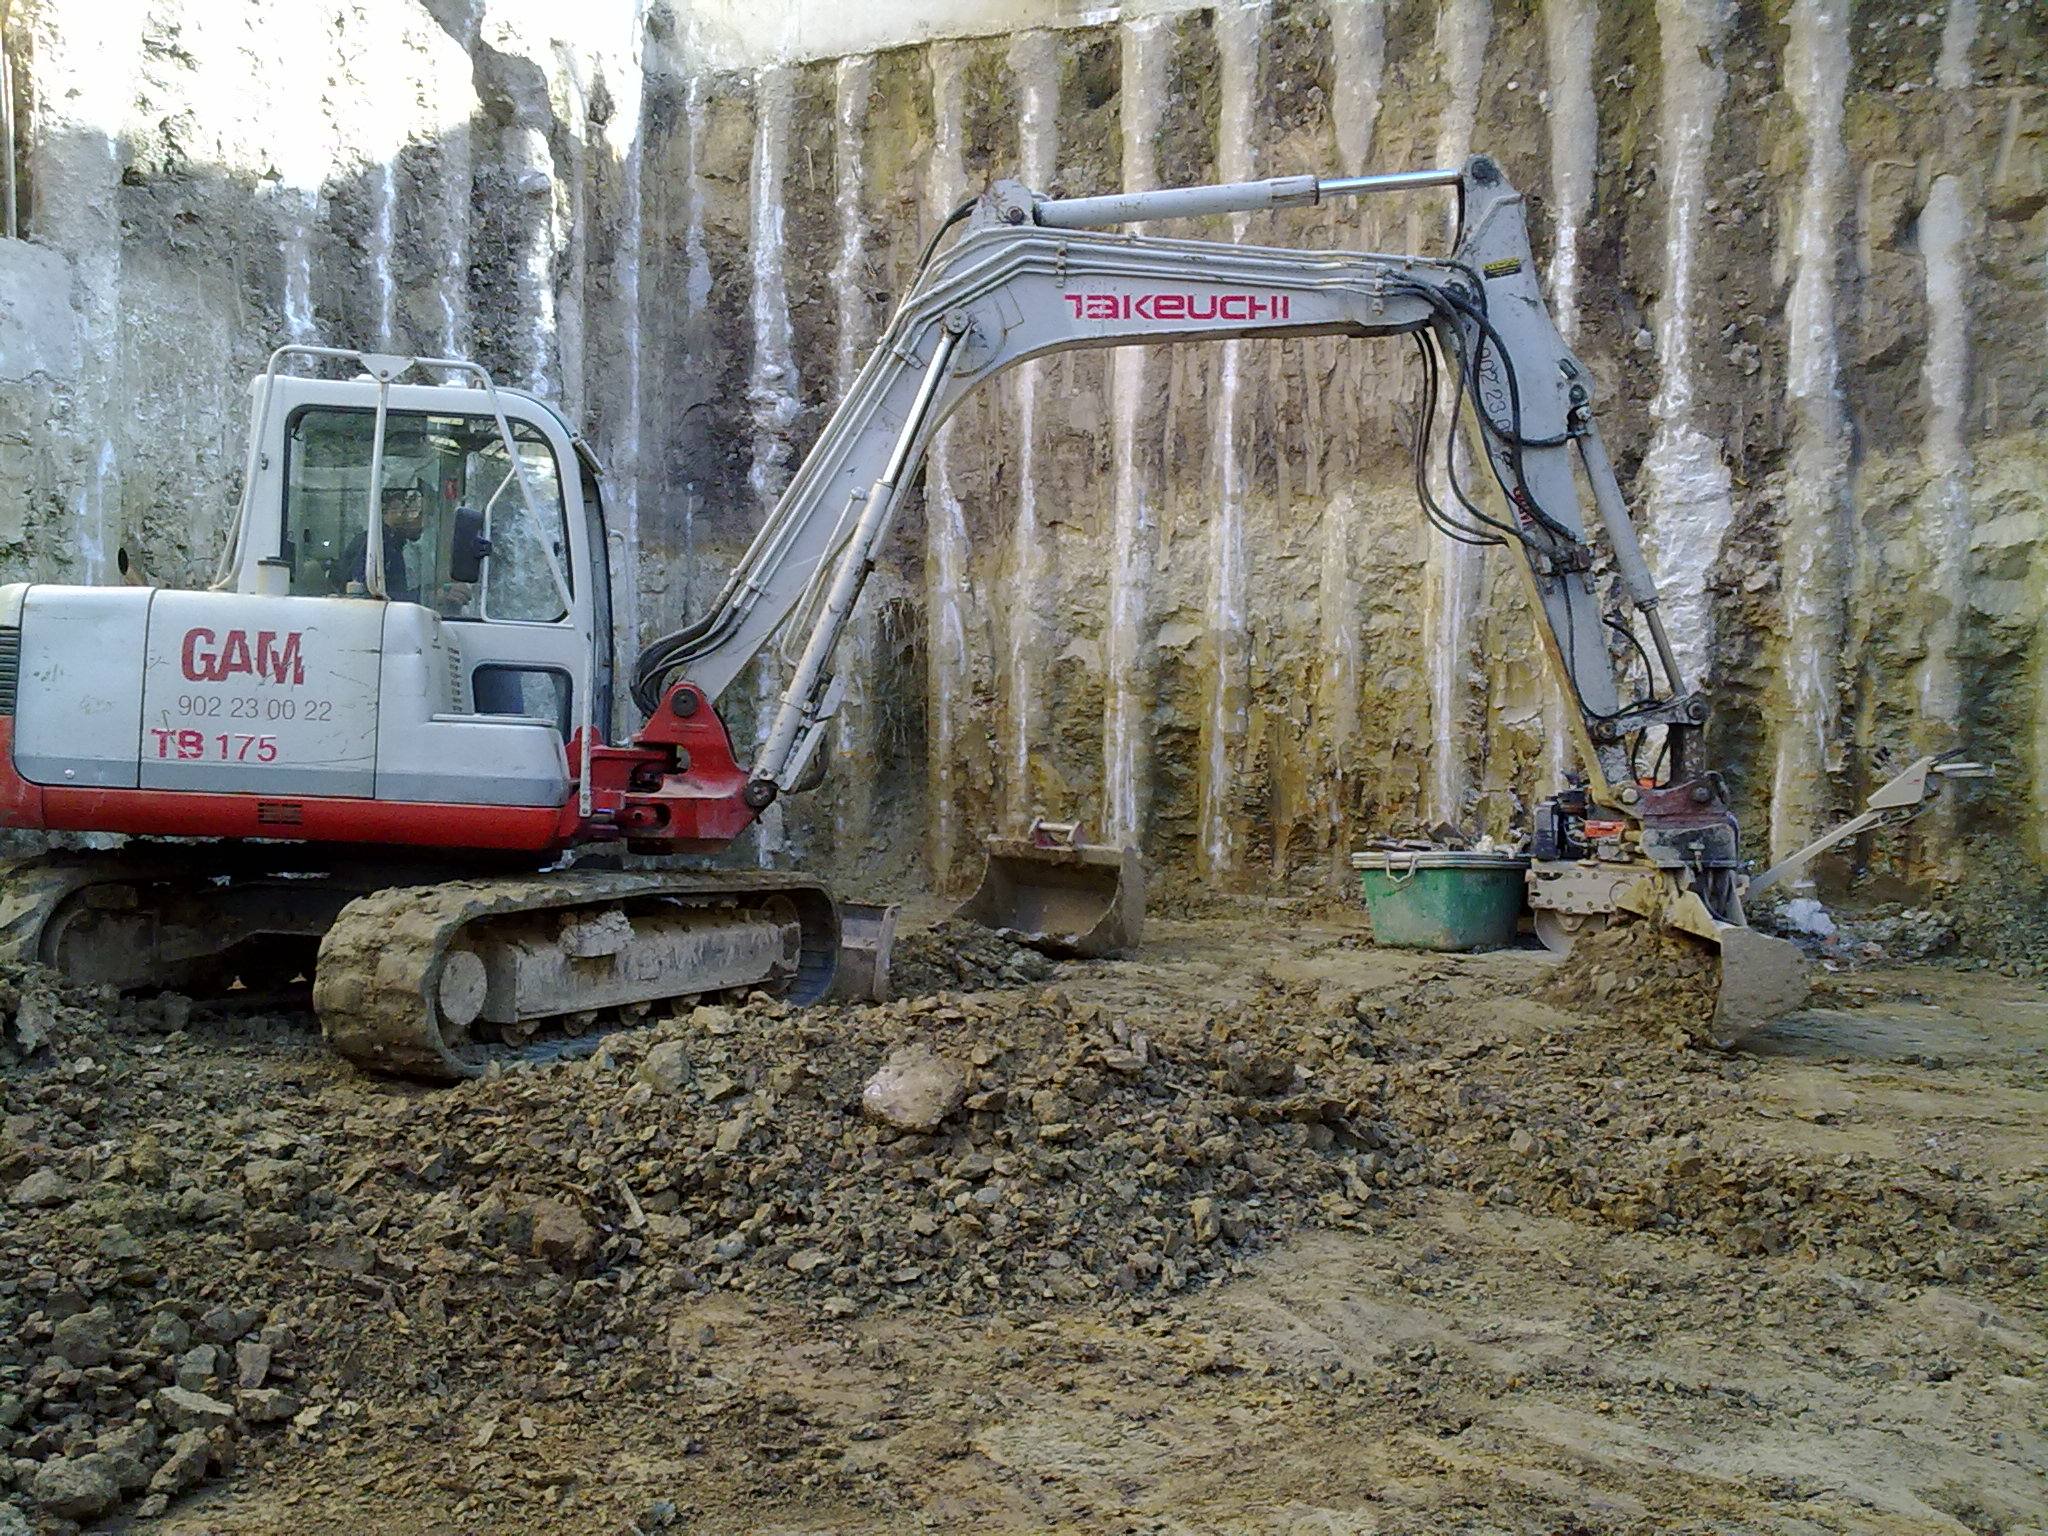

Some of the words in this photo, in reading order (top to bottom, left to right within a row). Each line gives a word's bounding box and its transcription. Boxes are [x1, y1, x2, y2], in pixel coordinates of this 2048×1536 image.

[181, 627, 304, 685] GAM
[178, 695, 222, 718] 902
[230, 697, 259, 719] 23
[267, 699, 296, 720] 00
[304, 700, 333, 722] 22
[151, 728, 205, 759] TB
[216, 734, 277, 762] 175
